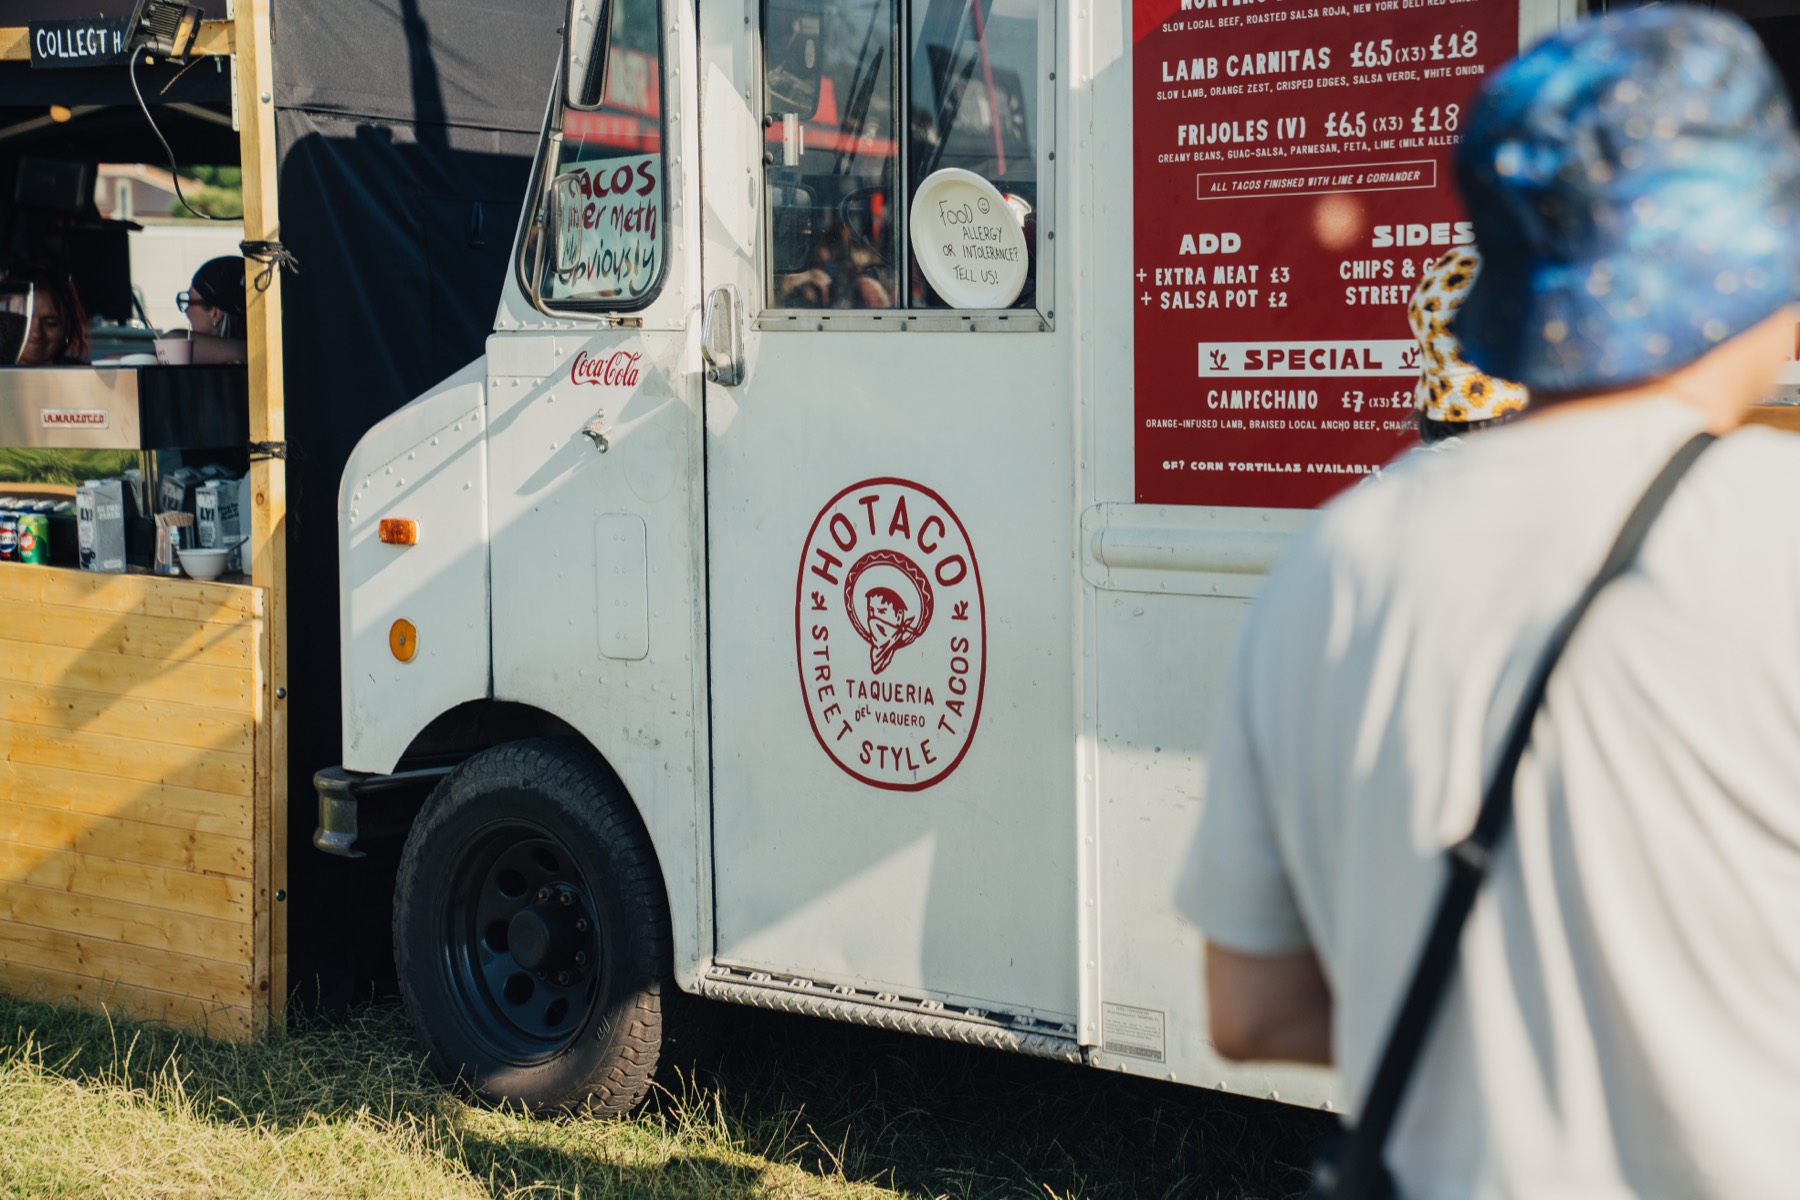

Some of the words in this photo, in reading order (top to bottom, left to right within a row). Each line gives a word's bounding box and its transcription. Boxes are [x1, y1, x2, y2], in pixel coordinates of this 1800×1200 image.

[1162, 22, 1184, 32] SLOW
[1187, 19, 1215, 30] LOCAL
[1218, 16, 1243, 27] BEEF,
[1246, 12, 1287, 24] ROASTED
[1290, 9, 1319, 20] SALSA
[1322, 6, 1350, 16] ROJA,
[1353, 3, 1371, 13] NEW
[1375, 0, 1399, 11] YORK
[1402, 0, 1424, 9] DELI
[37, 28, 107, 58] COLLECT
[1163, 57, 1218, 82] LAMB
[1226, 47, 1331, 77] CARNITAS
[1350, 39, 1393, 68] £6.5
[1429, 30, 1477, 60] £18
[1157, 90, 1178, 100] SLOW
[1182, 88, 1207, 98] LAMB,
[1210, 85, 1243, 96] ORANGE
[1247, 82, 1273, 93] ZEST,
[1276, 79, 1313, 91] CRISPED
[1317, 76, 1349, 88] EDGES,
[1353, 74, 1383, 85] SALSA
[1386, 70, 1420, 81] VERDE,
[1424, 67, 1451, 78] WHITE
[1455, 65, 1484, 76] ONION
[1178, 119, 1268, 146] FRIJOLES
[1277, 117, 1306, 139] (V)
[1324, 111, 1366, 137] £6.5
[1411, 104, 1459, 132] £18
[1158, 153, 1191, 163] CREAMY
[1194, 151, 1224, 161] BEANS,
[1227, 147, 1287, 159] GUAC-SALSA,
[1290, 143, 1340, 154] PARMESAN,
[1344, 141, 1371, 152] FETA,
[1374, 139, 1395, 150] LIME
[1399, 137, 1424, 148] (MILK
[1428, 134, 1466, 144] ALLERG
[1211, 182, 1227, 191] ALL
[1232, 180, 1261, 190] TACOS
[1264, 177, 1305, 189] FINISHED
[1308, 176, 1329, 186] WITH
[1332, 175, 1354, 185] LIME
[1356, 174, 1363, 184] &
[1366, 171, 1421, 183] CORIANDER
[963, 226, 1002, 243] ALLERGY
[1179, 232, 1241, 255] ADD
[1372, 221, 1476, 248] SIDES
[943, 244, 956, 257] OR
[962, 245, 1019, 262] INTOLERANCE?
[953, 264, 976, 282] TELL
[980, 270, 999, 285] US!
[1156, 267, 1206, 286] EXTRA
[1213, 265, 1259, 284] MEAT
[1270, 267, 1290, 283] £3
[1340, 259, 1394, 280] CHIPS
[1401, 258, 1415, 278] &
[1161, 290, 1219, 309] SALSA
[1226, 289, 1258, 308] POT
[1268, 292, 1287, 307] £2
[1345, 284, 1411, 306] STREET
[1244, 348, 1382, 370] SPECIAL
[1207, 390, 1318, 409] CAMPECHANO
[1341, 391, 1364, 412] £7
[1391, 391, 1417, 408] £2
[1146, 419, 1218, 428] ORANGE-INFUSED
[1221, 420, 1246, 430] LAMB,
[1249, 420, 1285, 429] BRAISED
[1289, 420, 1317, 429] LOCAL
[1321, 420, 1350, 431] ANCHO
[1353, 420, 1380, 431] BEEF,
[1190, 461, 1223, 471] CORN
[1228, 462, 1301, 472] TORTILLAS
[1307, 463, 1380, 474] AVAILABLE
[811, 495, 968, 587] HOTACO
[811, 624, 853, 741] STREET
[860, 739, 937, 771] STYLE
[938, 636, 969, 736] TACOS
[846, 679, 934, 705] TAQUERIA
[875, 711, 925, 728] VAQUERO
